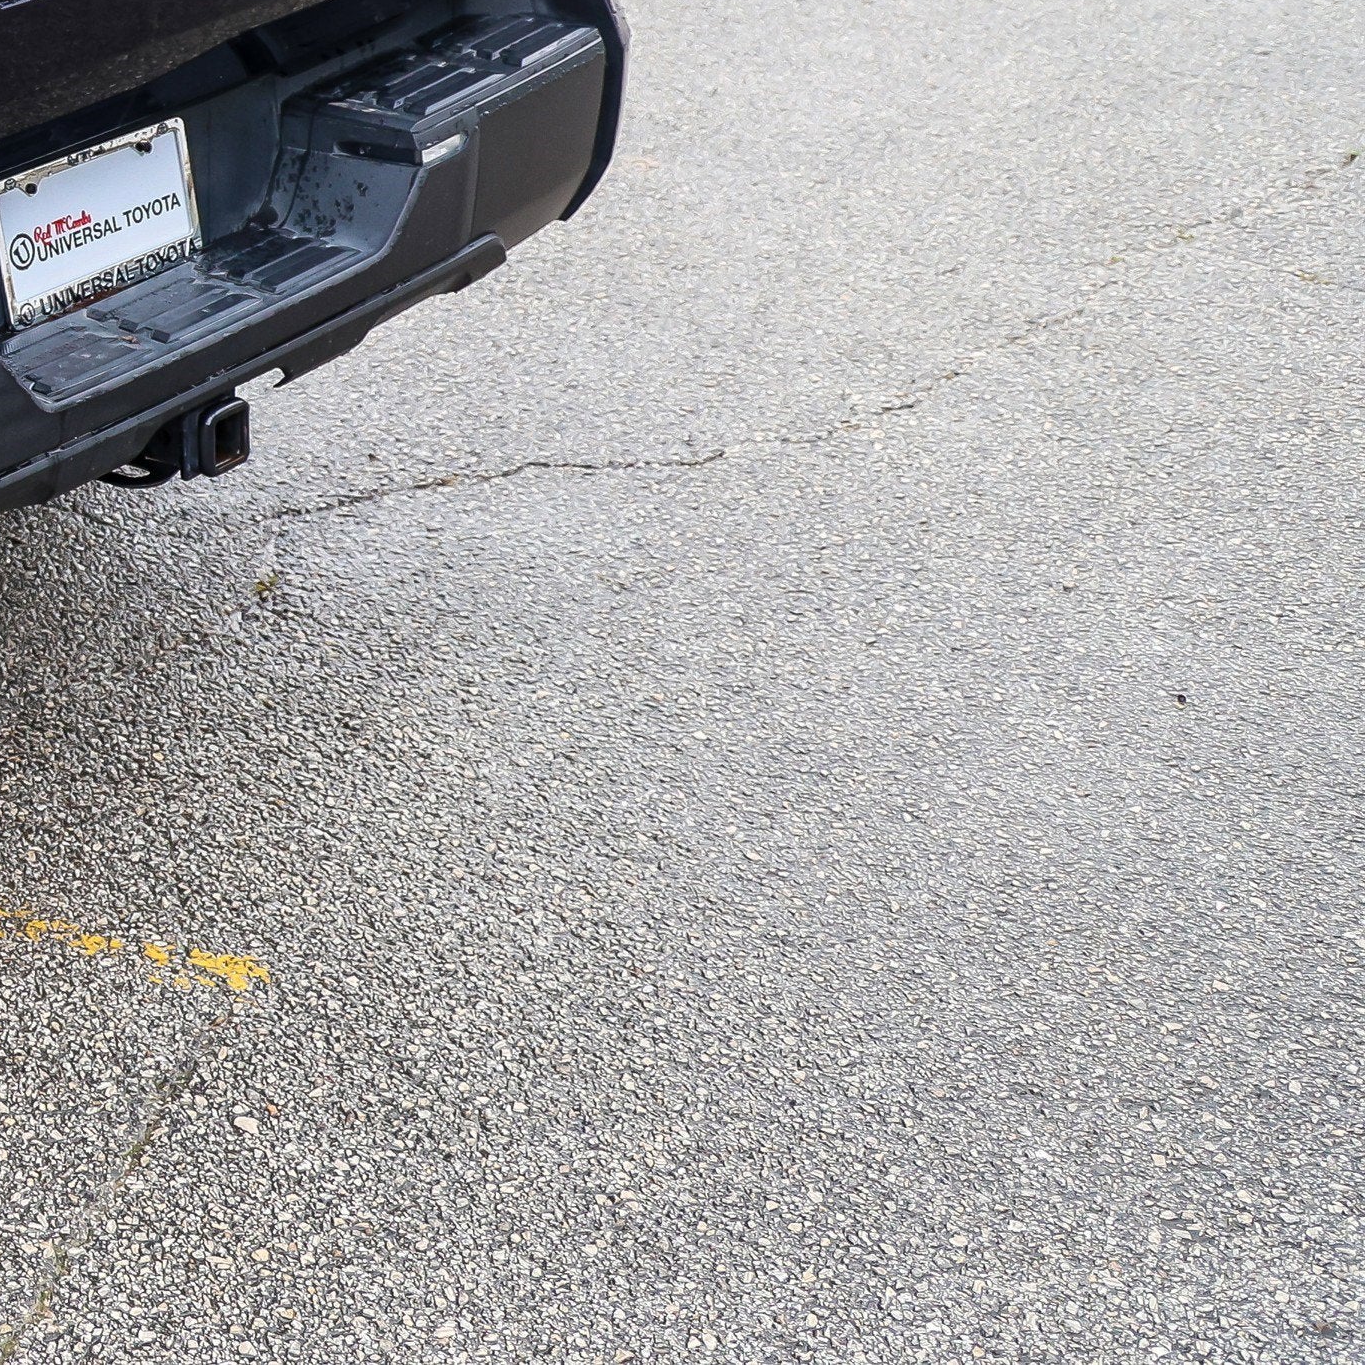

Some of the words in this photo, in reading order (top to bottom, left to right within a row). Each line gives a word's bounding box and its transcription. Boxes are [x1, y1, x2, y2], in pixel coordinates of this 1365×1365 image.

[34, 224, 51, 246] Red
[36, 216, 122, 261] UNIVERSAL
[123, 193, 181, 227] TOYOTA
[39, 263, 136, 315] UNIVERSAL
[135, 238, 199, 275] TOYOTA
